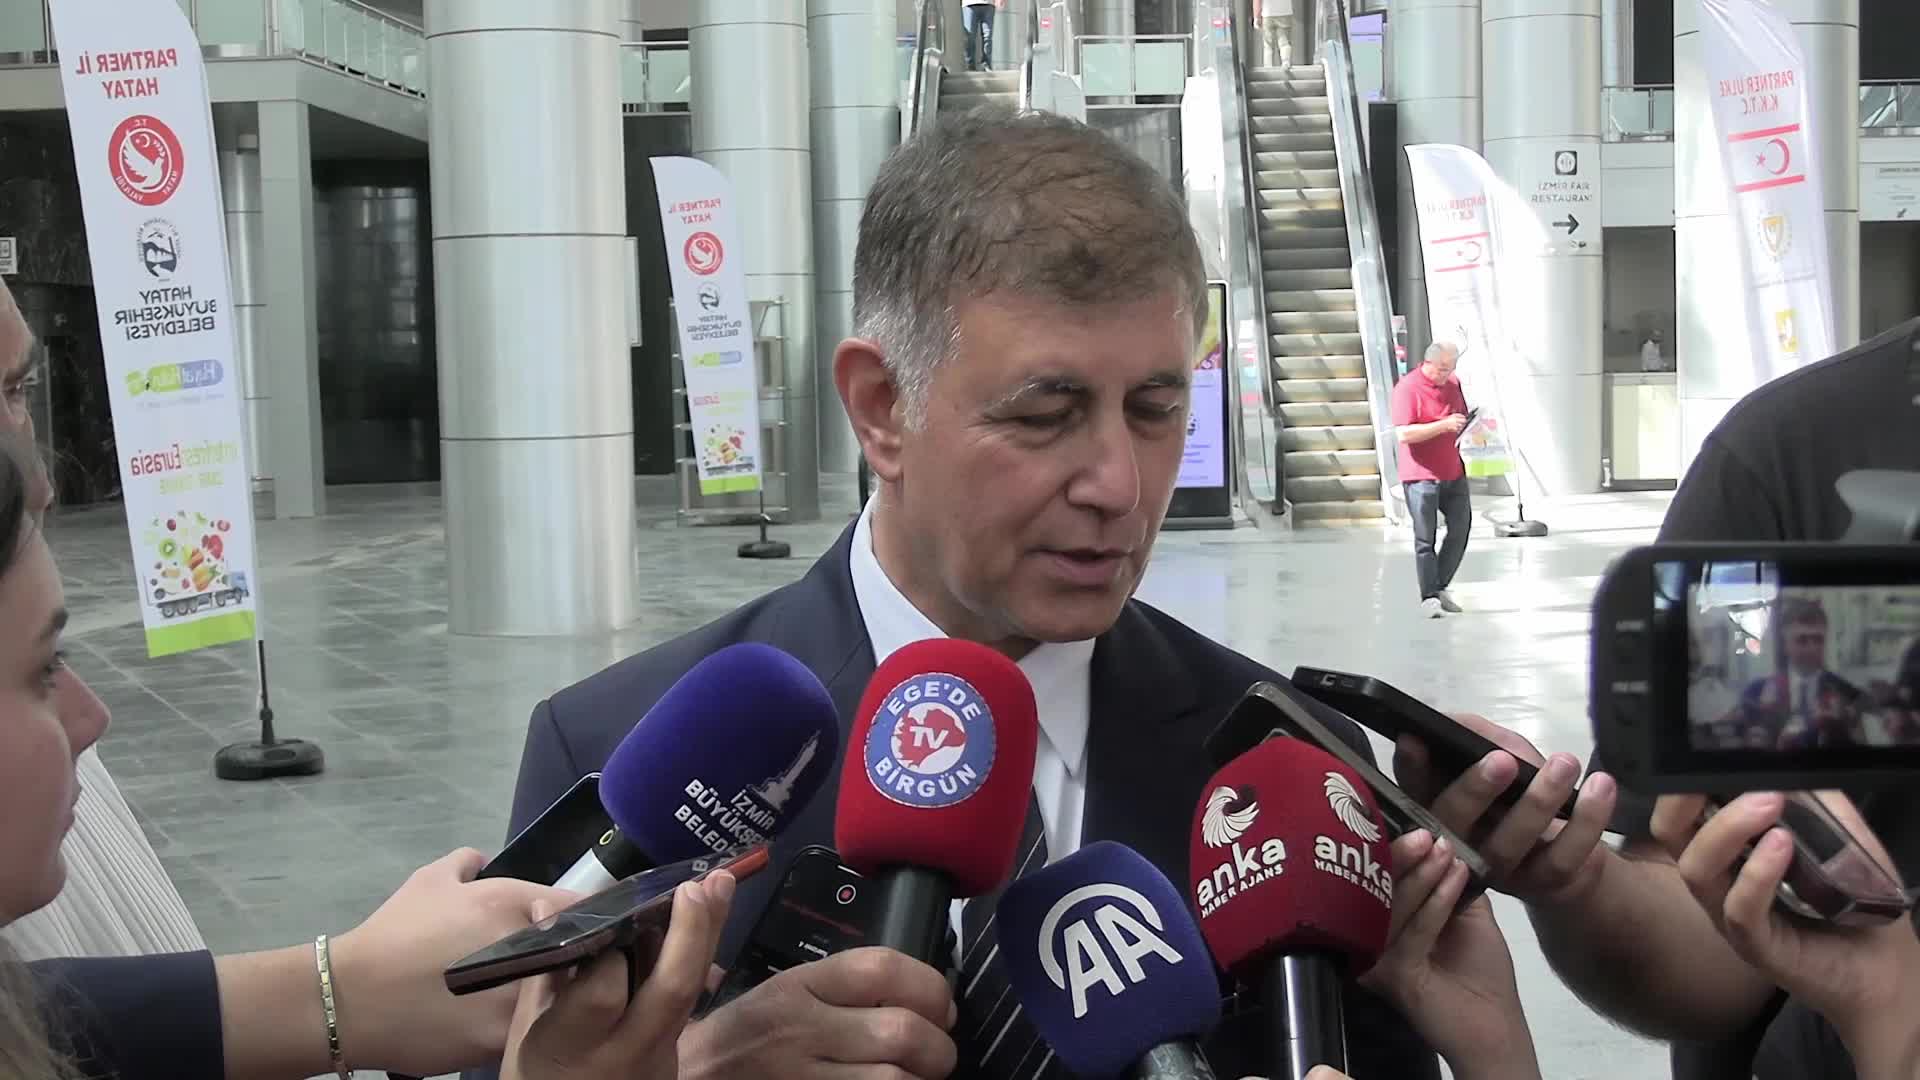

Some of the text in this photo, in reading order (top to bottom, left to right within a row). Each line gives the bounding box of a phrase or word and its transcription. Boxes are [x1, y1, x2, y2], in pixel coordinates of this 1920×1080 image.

[887, 681, 982, 720] EGE'DE
[909, 726, 949, 750] TV
[874, 756, 977, 798] BİRGÜN
[730, 789, 776, 830] İZMİR
[1197, 838, 1287, 907] anka
[1314, 835, 1393, 900] anka
[1314, 859, 1359, 886] HABER
[1201, 863, 1284, 919] HABER AJANS
[1063, 903, 1185, 1019] AA
